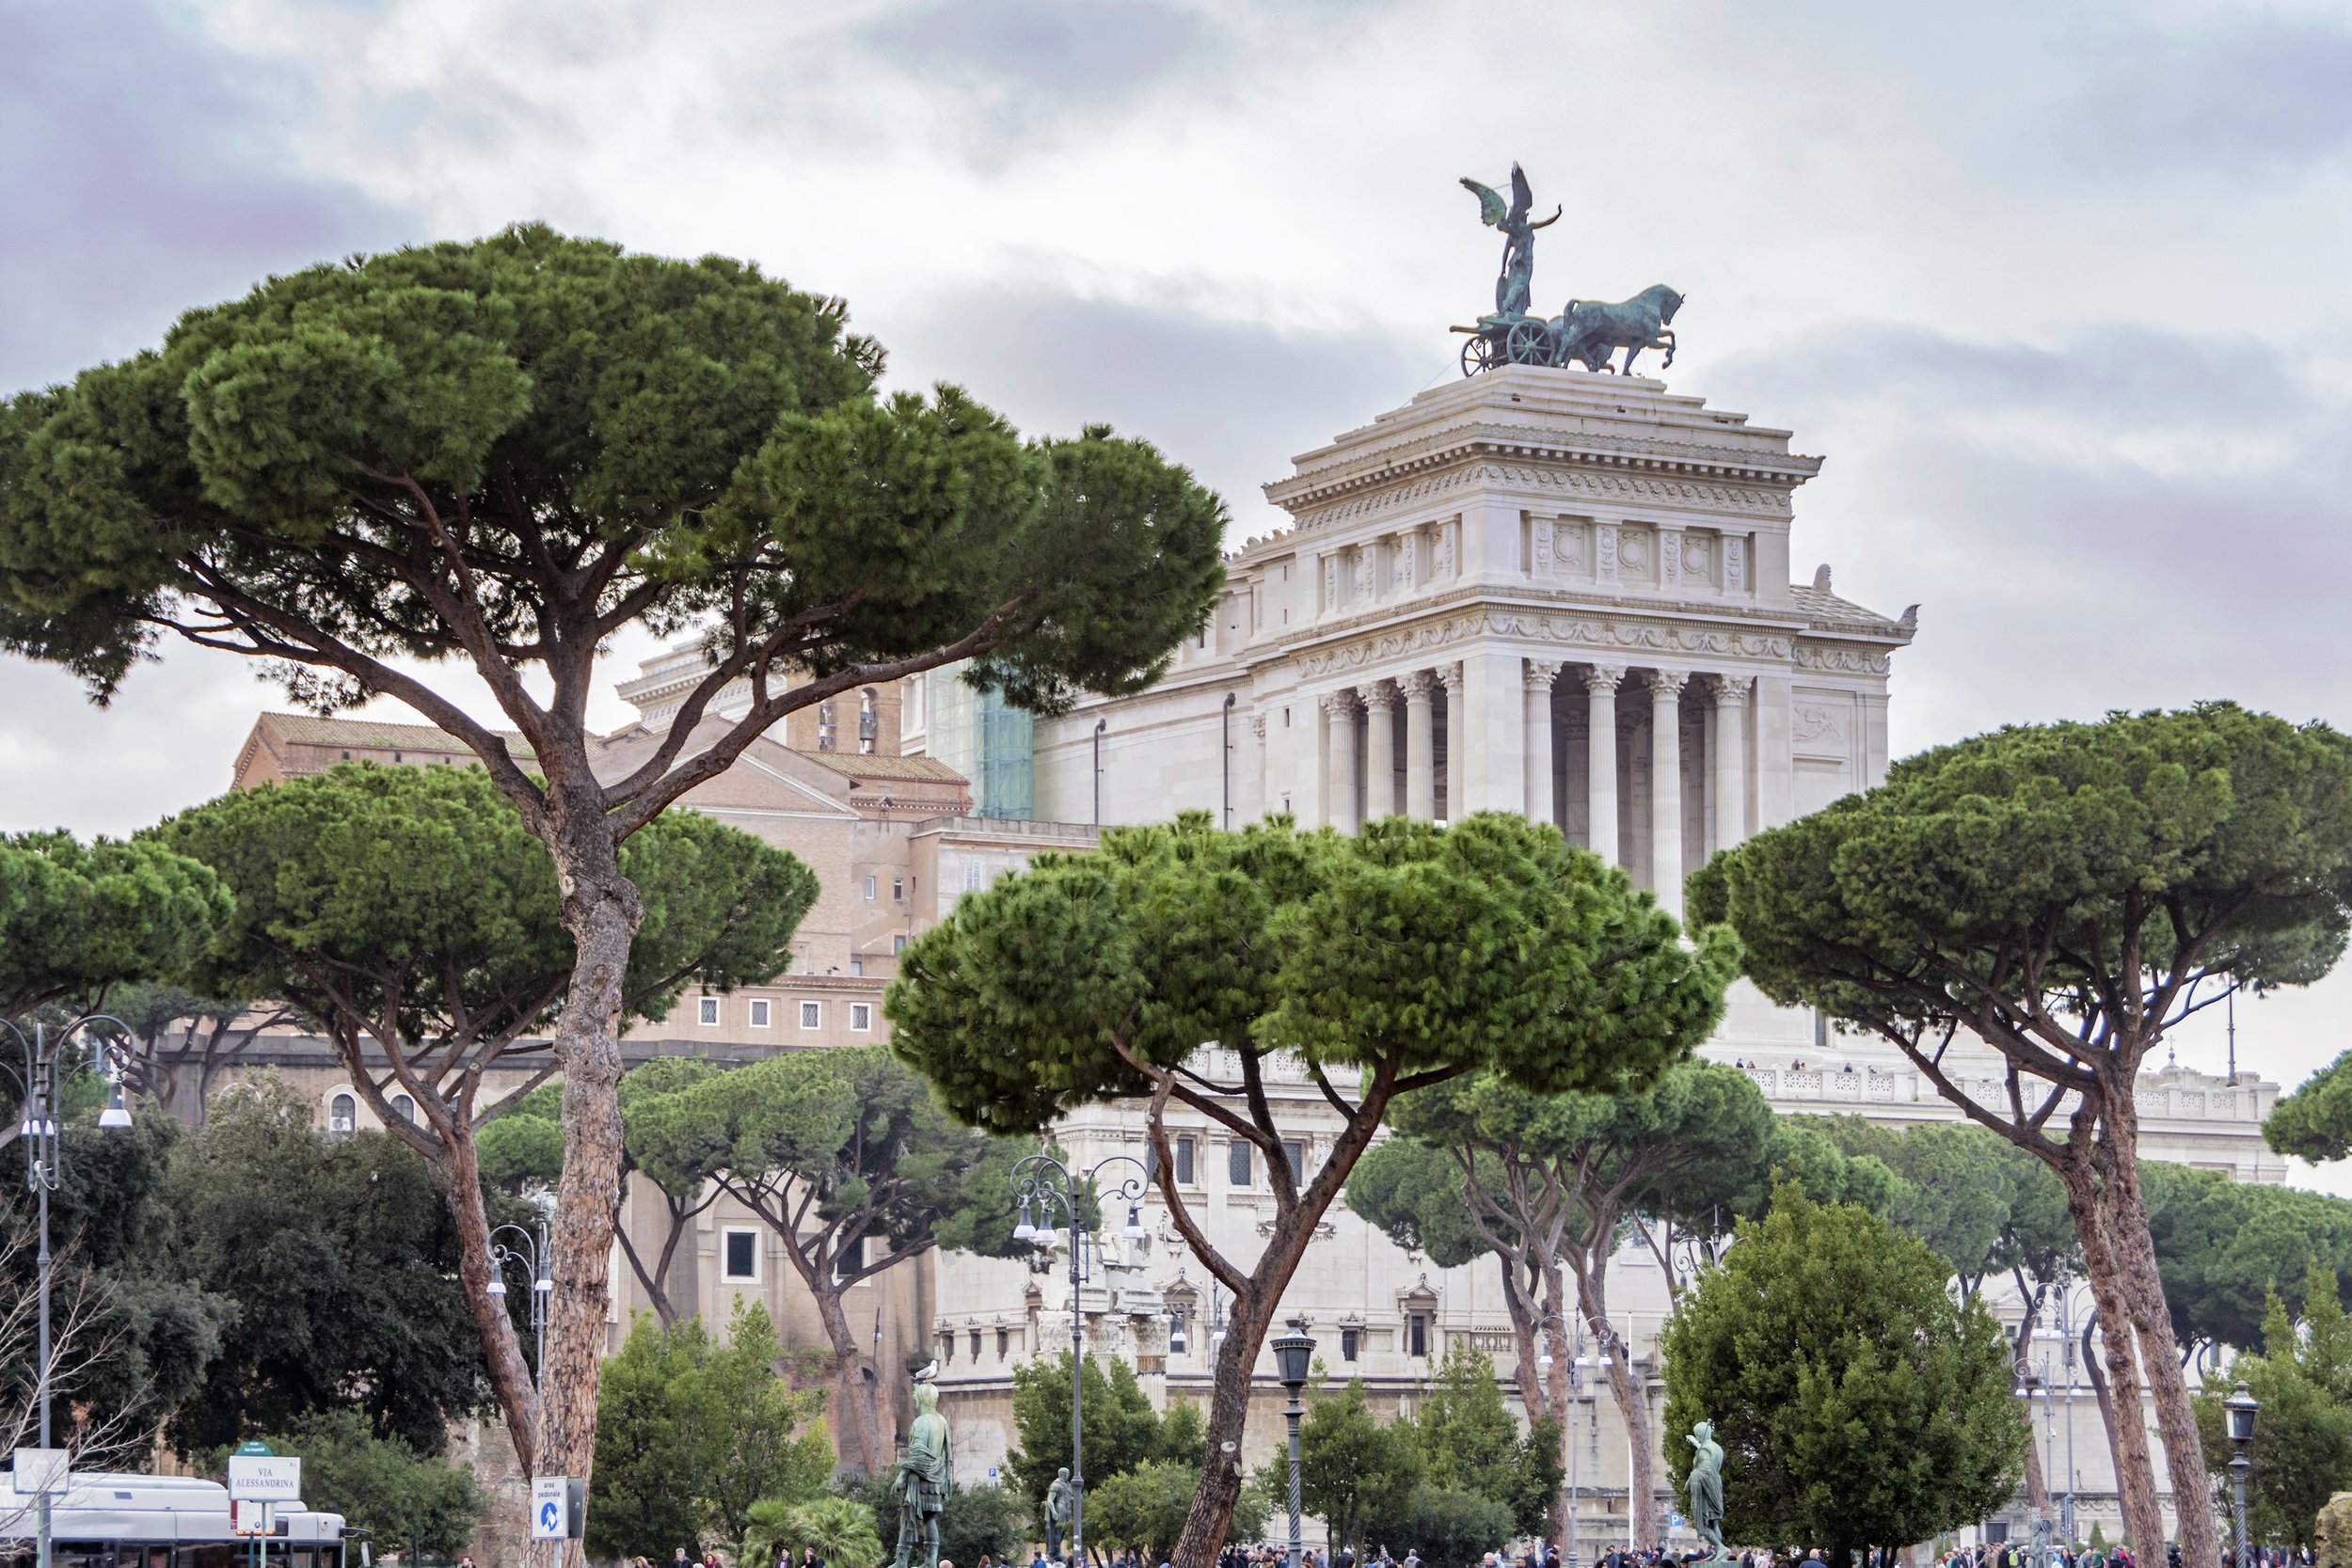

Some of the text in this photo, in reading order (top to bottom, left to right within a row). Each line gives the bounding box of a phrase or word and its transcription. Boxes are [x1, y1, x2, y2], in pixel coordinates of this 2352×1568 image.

[258, 1467, 273, 1477] VIA
[236, 1478, 294, 1488] ALESSANDRINA
[1671, 1514, 1679, 1526] P
